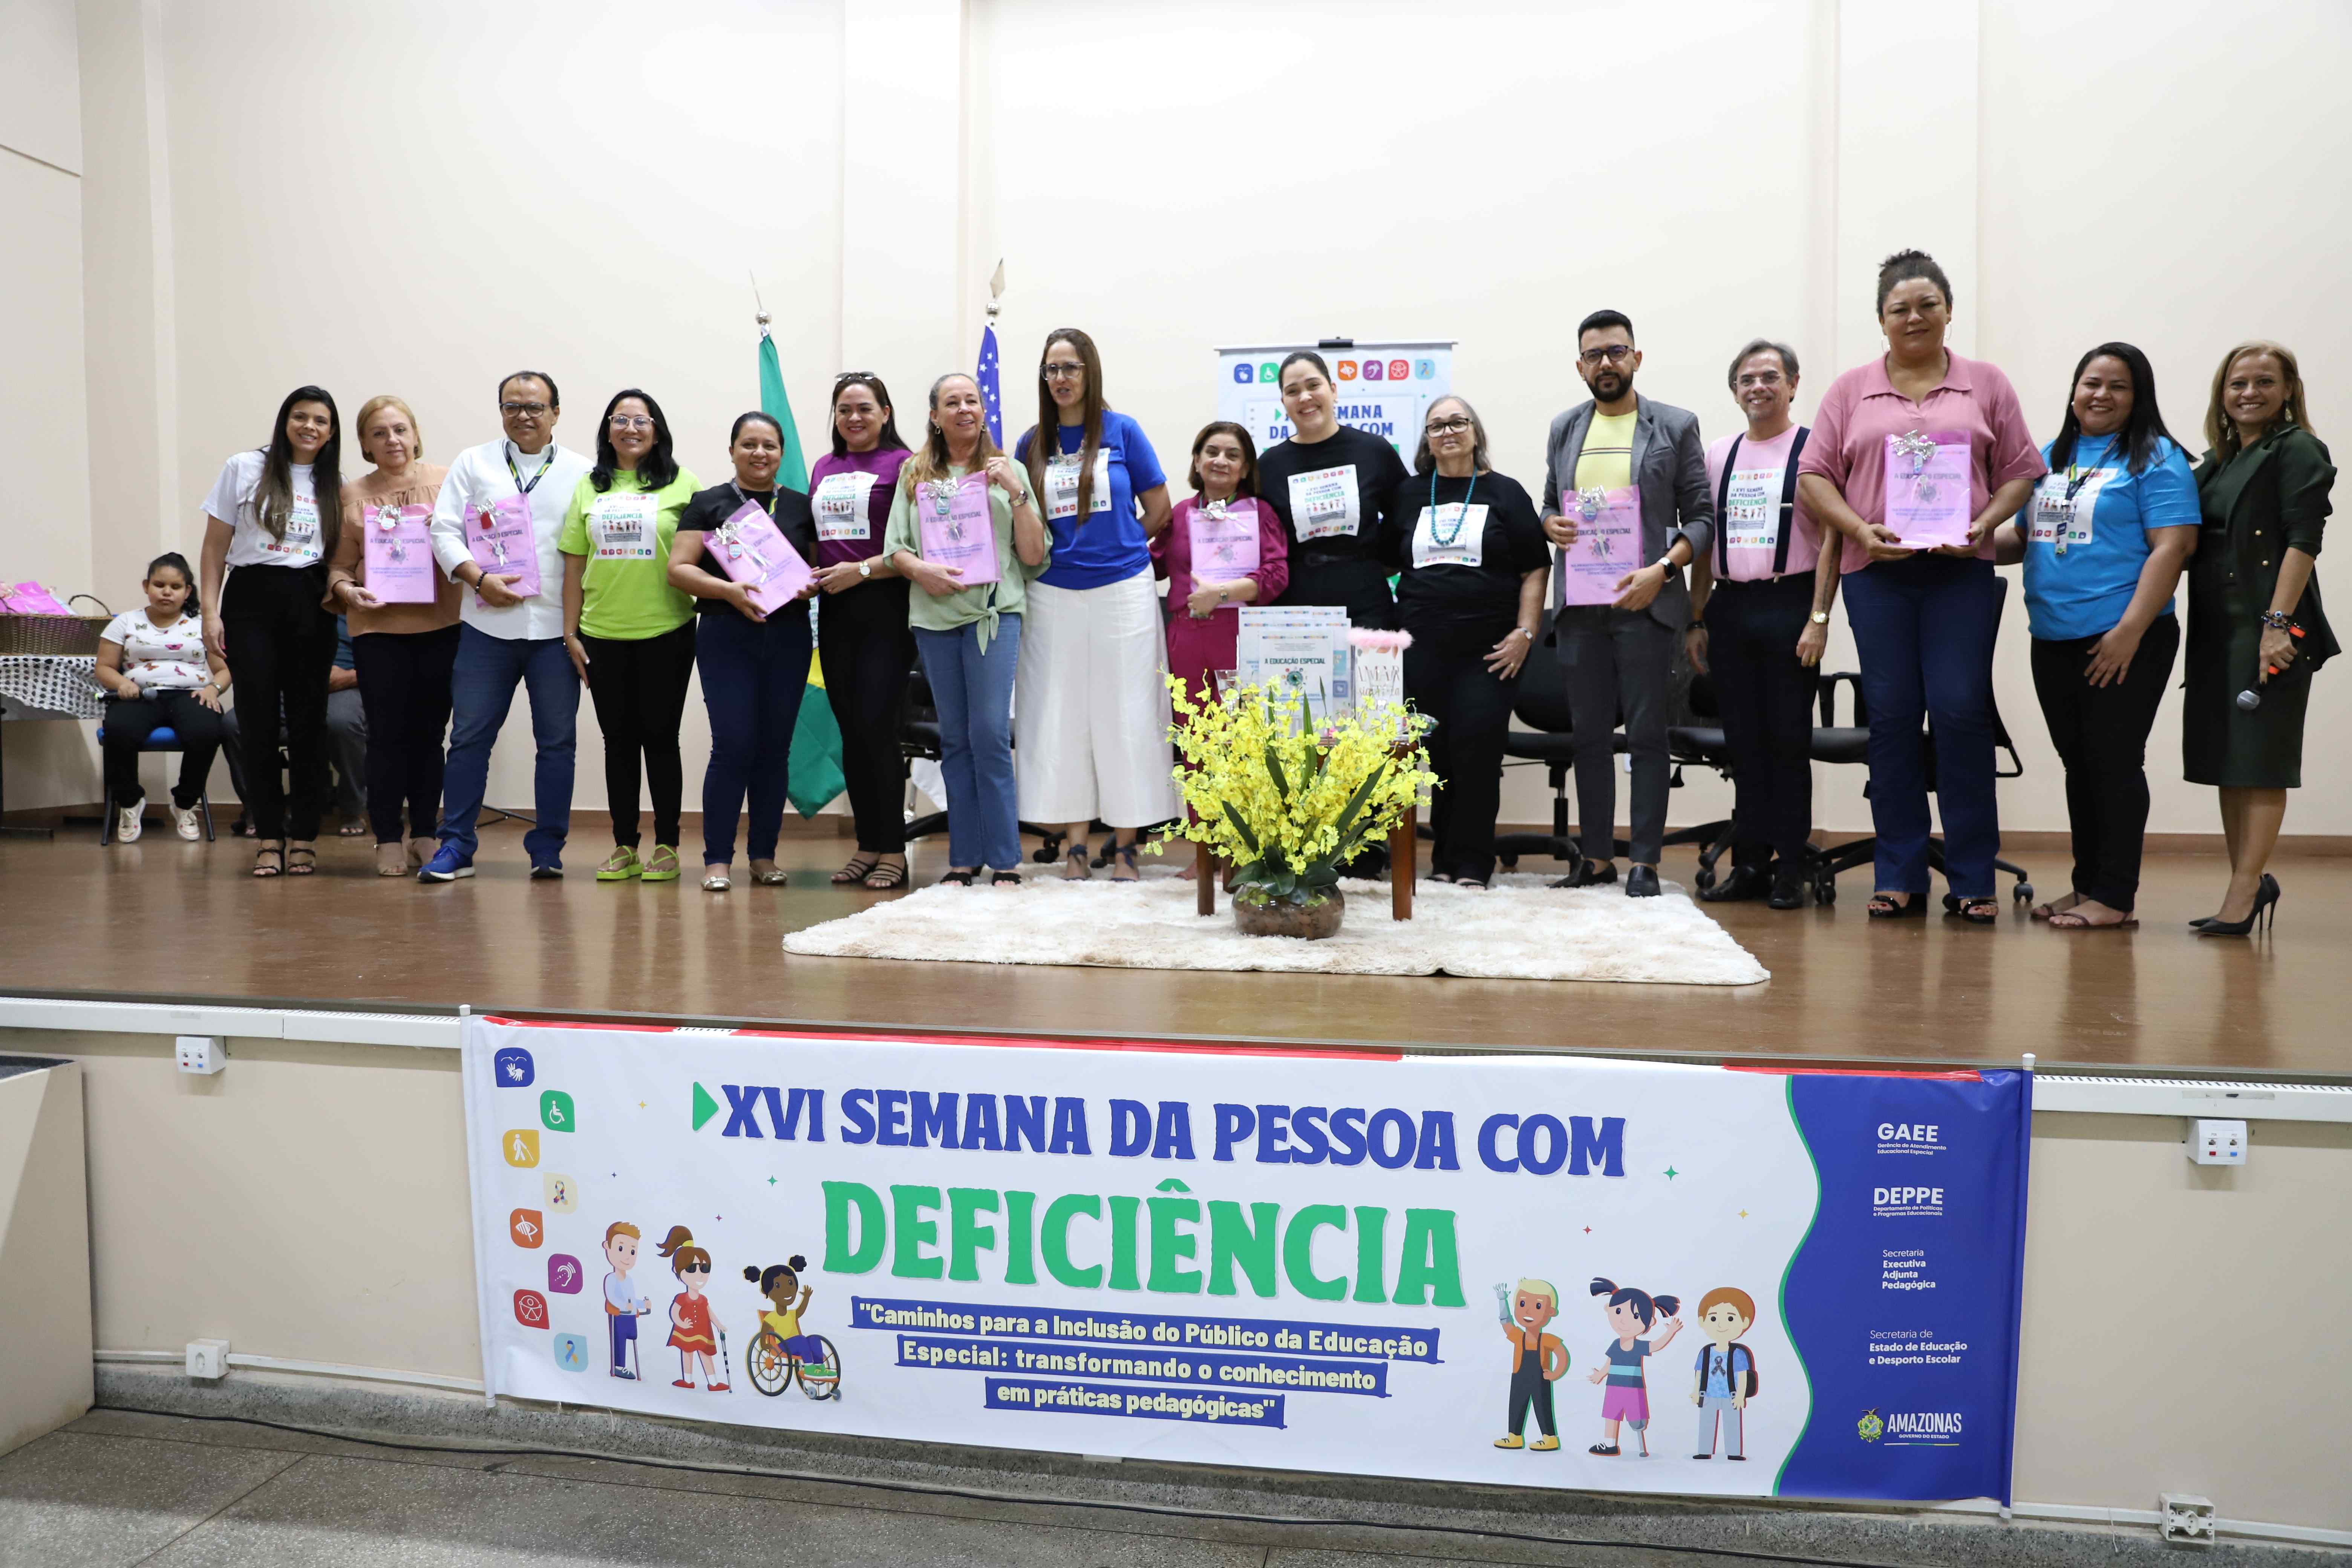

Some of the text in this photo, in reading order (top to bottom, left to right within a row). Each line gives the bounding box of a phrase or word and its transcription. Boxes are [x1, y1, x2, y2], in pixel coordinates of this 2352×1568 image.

[1269, 426, 1289, 439] DA
[721, 1085, 1626, 1176] XVI SEMANA DA PESSOA COM
[1877, 1122, 1939, 1142] GAEE
[1873, 1187, 1944, 1205] DEPPE
[822, 1179, 1466, 1307] DEFICIÊNCIA
[1883, 1249, 1924, 1257] Secretaria
[1883, 1259, 1926, 1268] Executiva
[1882, 1270, 1918, 1280] Adjunta
[1882, 1280, 1936, 1291] Pedagógica
[980, 1316, 1029, 1335] para
[1035, 1319, 1048, 1334] a
[1054, 1315, 1147, 1341] Inclusão
[1153, 1322, 1180, 1341] do
[1185, 1323, 1269, 1347] Público
[1275, 1329, 1302, 1349] da
[1309, 1330, 1428, 1359] Educação
[1870, 1329, 1933, 1339] Secretaria de
[1869, 1341, 1968, 1353] Estado de Educação
[903, 1341, 1376, 1390] Especial: transformando o conhecimento
[1877, 1356, 1924, 1366] Desporto
[1926, 1354, 1962, 1364] Escolar
[997, 1386, 1275, 1420] em práticas pedagógicas"
[1887, 1412, 1962, 1433] AMAZONAS
